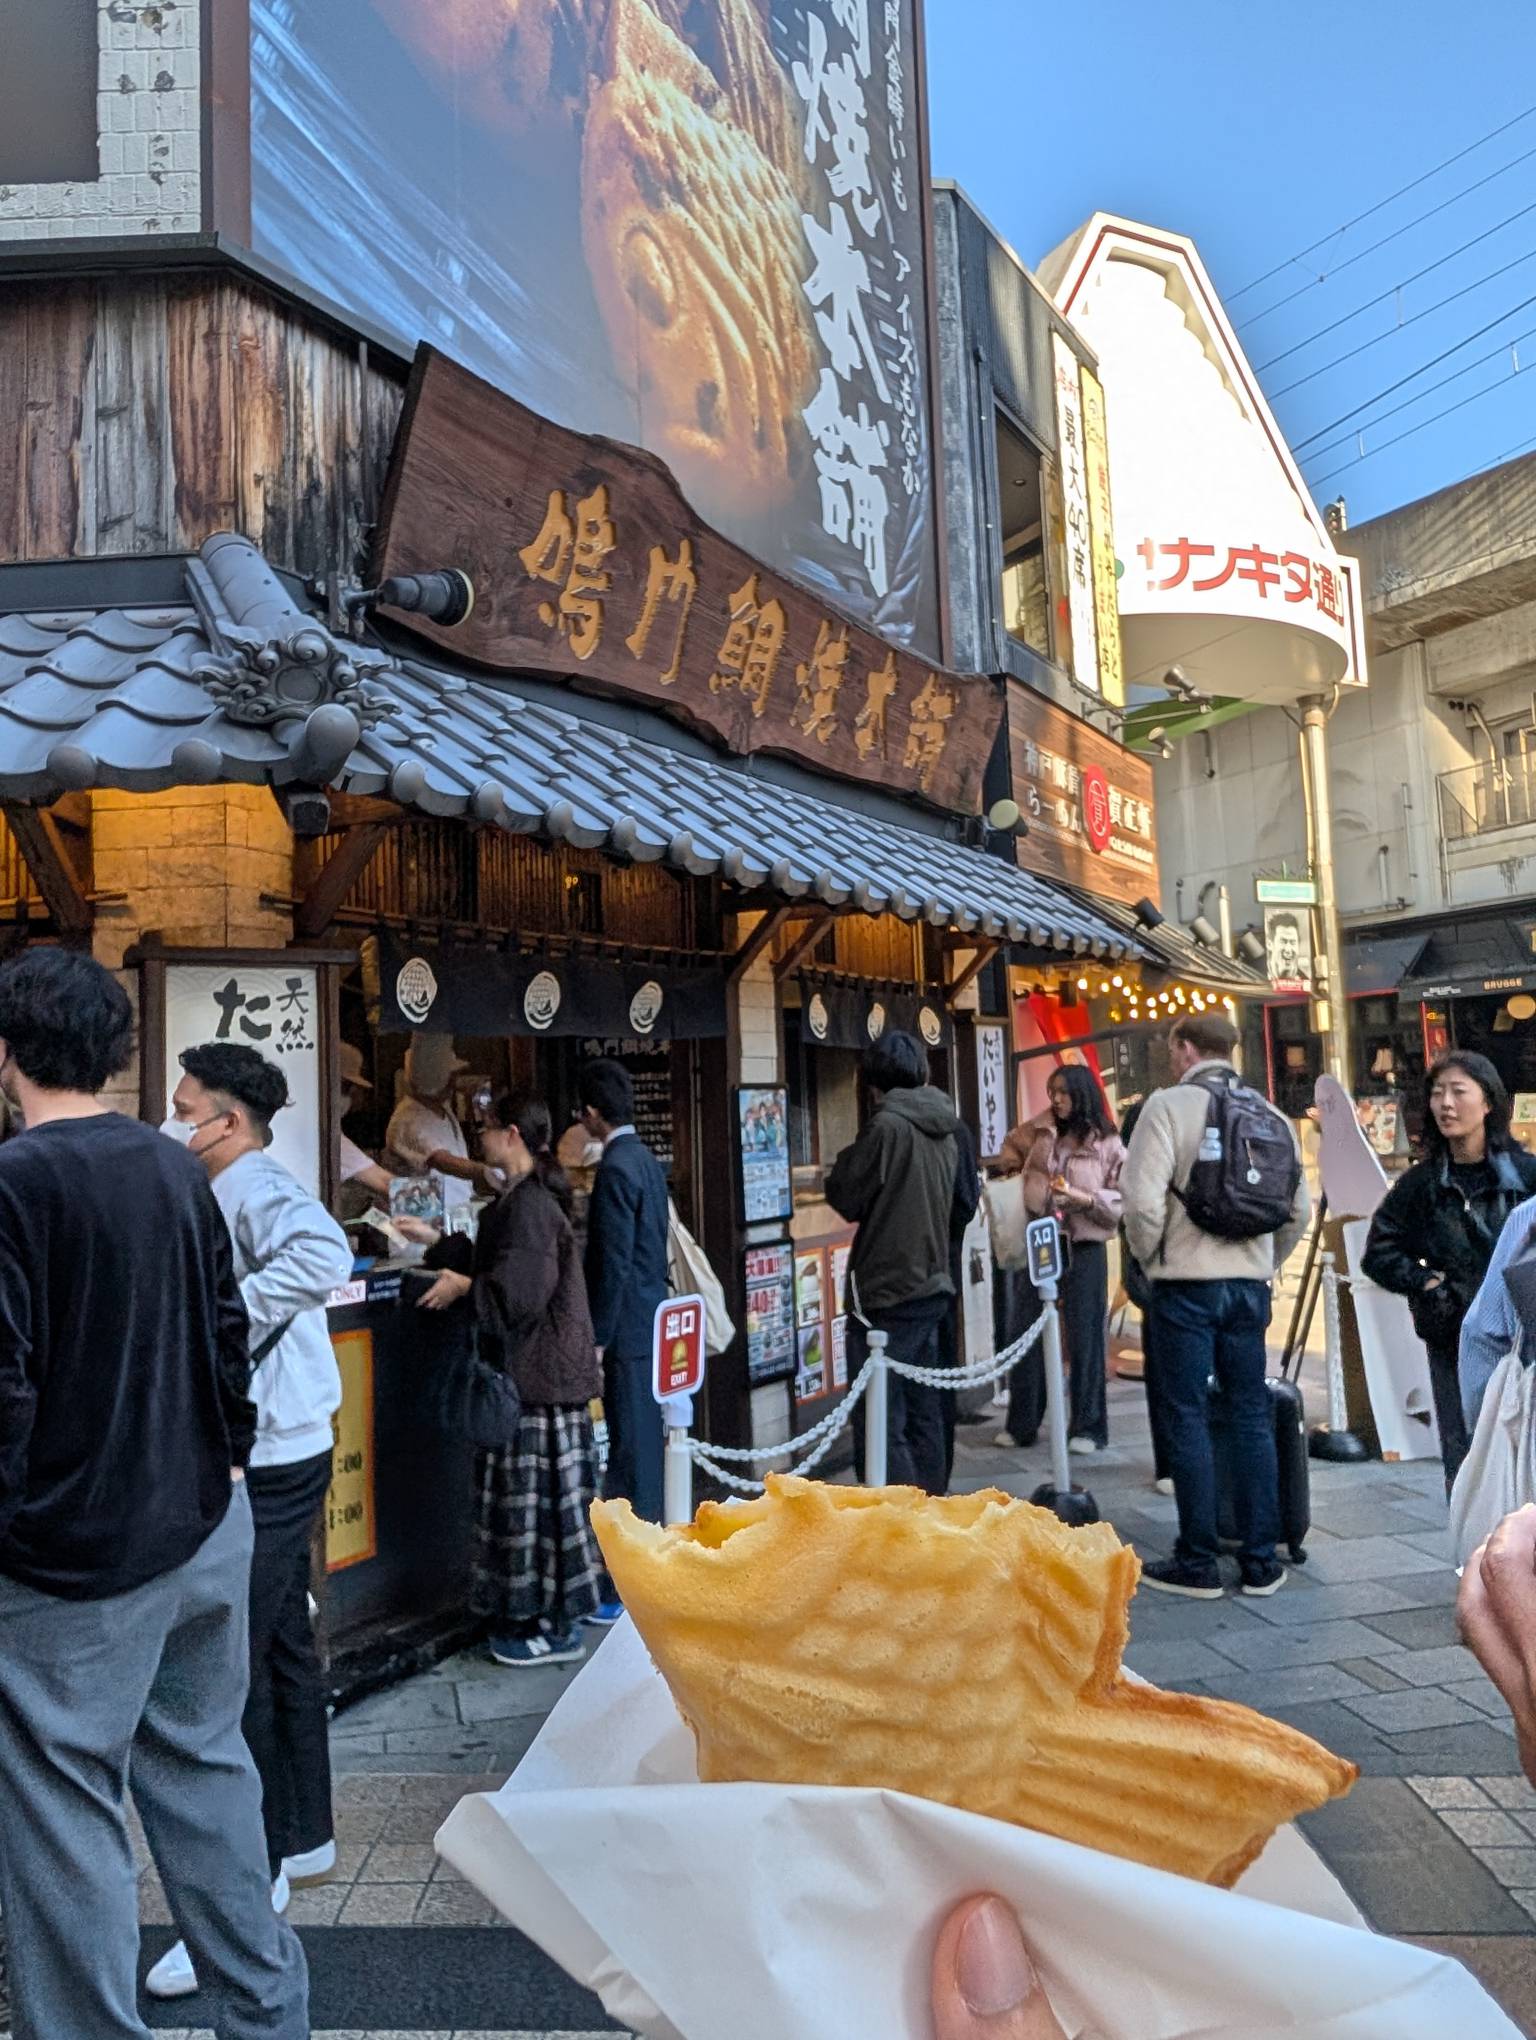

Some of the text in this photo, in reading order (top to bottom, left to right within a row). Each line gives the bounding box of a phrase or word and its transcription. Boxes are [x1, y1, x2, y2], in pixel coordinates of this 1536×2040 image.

[518, 484, 960, 793] 鳴門鯛焼本舗
[276, 977, 315, 1054] 天然
[983, 1030, 997, 1154] たいやき
[1033, 1226, 1052, 1248] 入口
[665, 1309, 696, 1341] 出口
